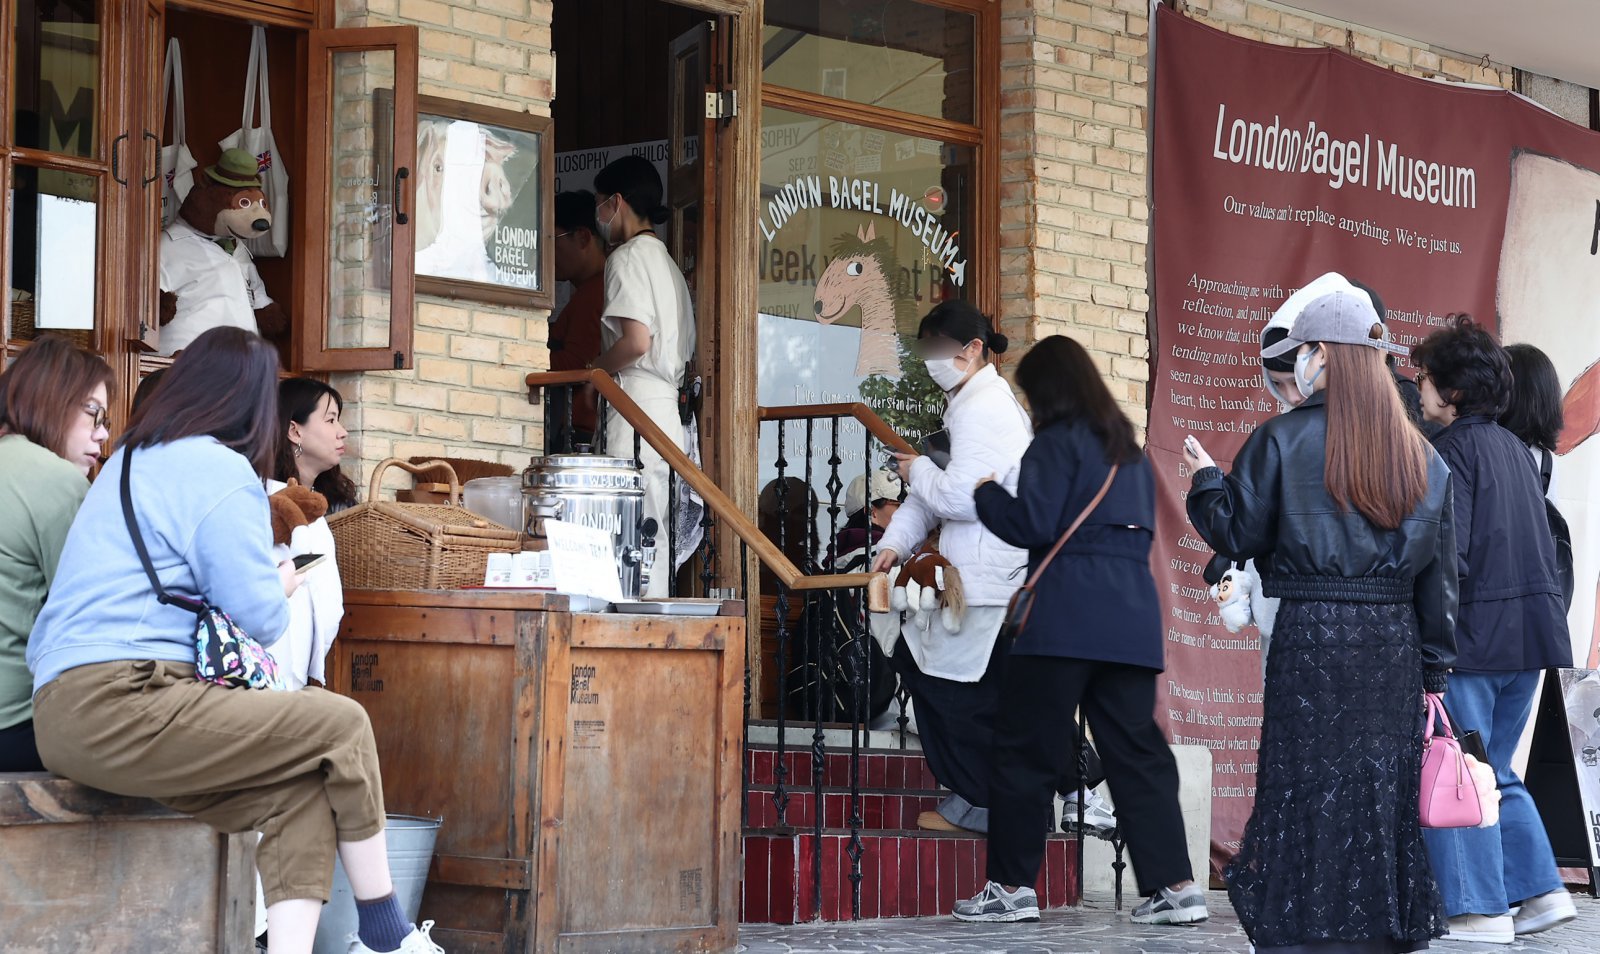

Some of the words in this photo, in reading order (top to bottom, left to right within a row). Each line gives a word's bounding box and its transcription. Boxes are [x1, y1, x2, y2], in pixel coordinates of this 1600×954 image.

[761, 128, 800, 149] SOPHY
[789, 157, 805, 172] SEP
[1213, 103, 1299, 173] London
[1300, 121, 1369, 189] Bagel
[1376, 139, 1476, 208] Museum
[759, 175, 822, 243] LONDON
[829, 175, 883, 215] BAGEL
[889, 187, 961, 269] MUSEUM
[1223, 195, 1245, 216] Our
[1248, 203, 1276, 220] values
[1294, 207, 1336, 229] replace
[1339, 215, 1392, 246] anything.
[1395, 227, 1428, 250] We're
[1428, 235, 1448, 254] just
[1449, 239, 1463, 254] us.
[495, 225, 537, 250] LONDON
[495, 246, 528, 267] BAGEL
[495, 265, 537, 286] MUSEUM
[1187, 272, 1249, 300] Approaching
[1262, 284, 1284, 299] with
[1182, 298, 1234, 320] reflection,
[1178, 322, 1196, 336] we
[1197, 323, 1225, 341] know
[1400, 330, 1418, 346] into
[1171, 344, 1212, 366] tending
[1213, 352, 1228, 364] not
[1228, 353, 1238, 366] to
[1169, 369, 1191, 384] seen
[1193, 373, 1204, 386] as
[1205, 377, 1212, 386] a
[1213, 374, 1267, 392] cowardly
[861, 394, 914, 412] understand
[915, 400, 923, 413] it
[927, 401, 945, 417] only
[1170, 388, 1196, 410] heart,
[1199, 394, 1216, 410] the
[1258, 398, 1272, 413] the
[889, 421, 922, 444] knowing
[1172, 416, 1185, 428] we
[1187, 420, 1214, 432] must
[590, 475, 635, 488] WELCOME
[1171, 556, 1191, 574] sive
[1192, 561, 1202, 575] to
[1181, 583, 1210, 605] simply
[1183, 607, 1202, 624] time.
[1204, 612, 1221, 625] And
[1168, 627, 1180, 642] the
[1198, 634, 1207, 648] of
[1207, 634, 1261, 651] "accumulati
[571, 663, 596, 679] London
[1168, 680, 1181, 697] The
[1182, 684, 1204, 704] beauty
[1207, 688, 1211, 702] I
[1213, 688, 1235, 703] think
[1237, 689, 1245, 703] is
[1186, 709, 1195, 723] all
[1197, 710, 1208, 725] the
[1209, 711, 1226, 728] soft,
[1228, 736, 1248, 750] when
[1215, 760, 1238, 776] work,
[1218, 783, 1245, 798] natural
